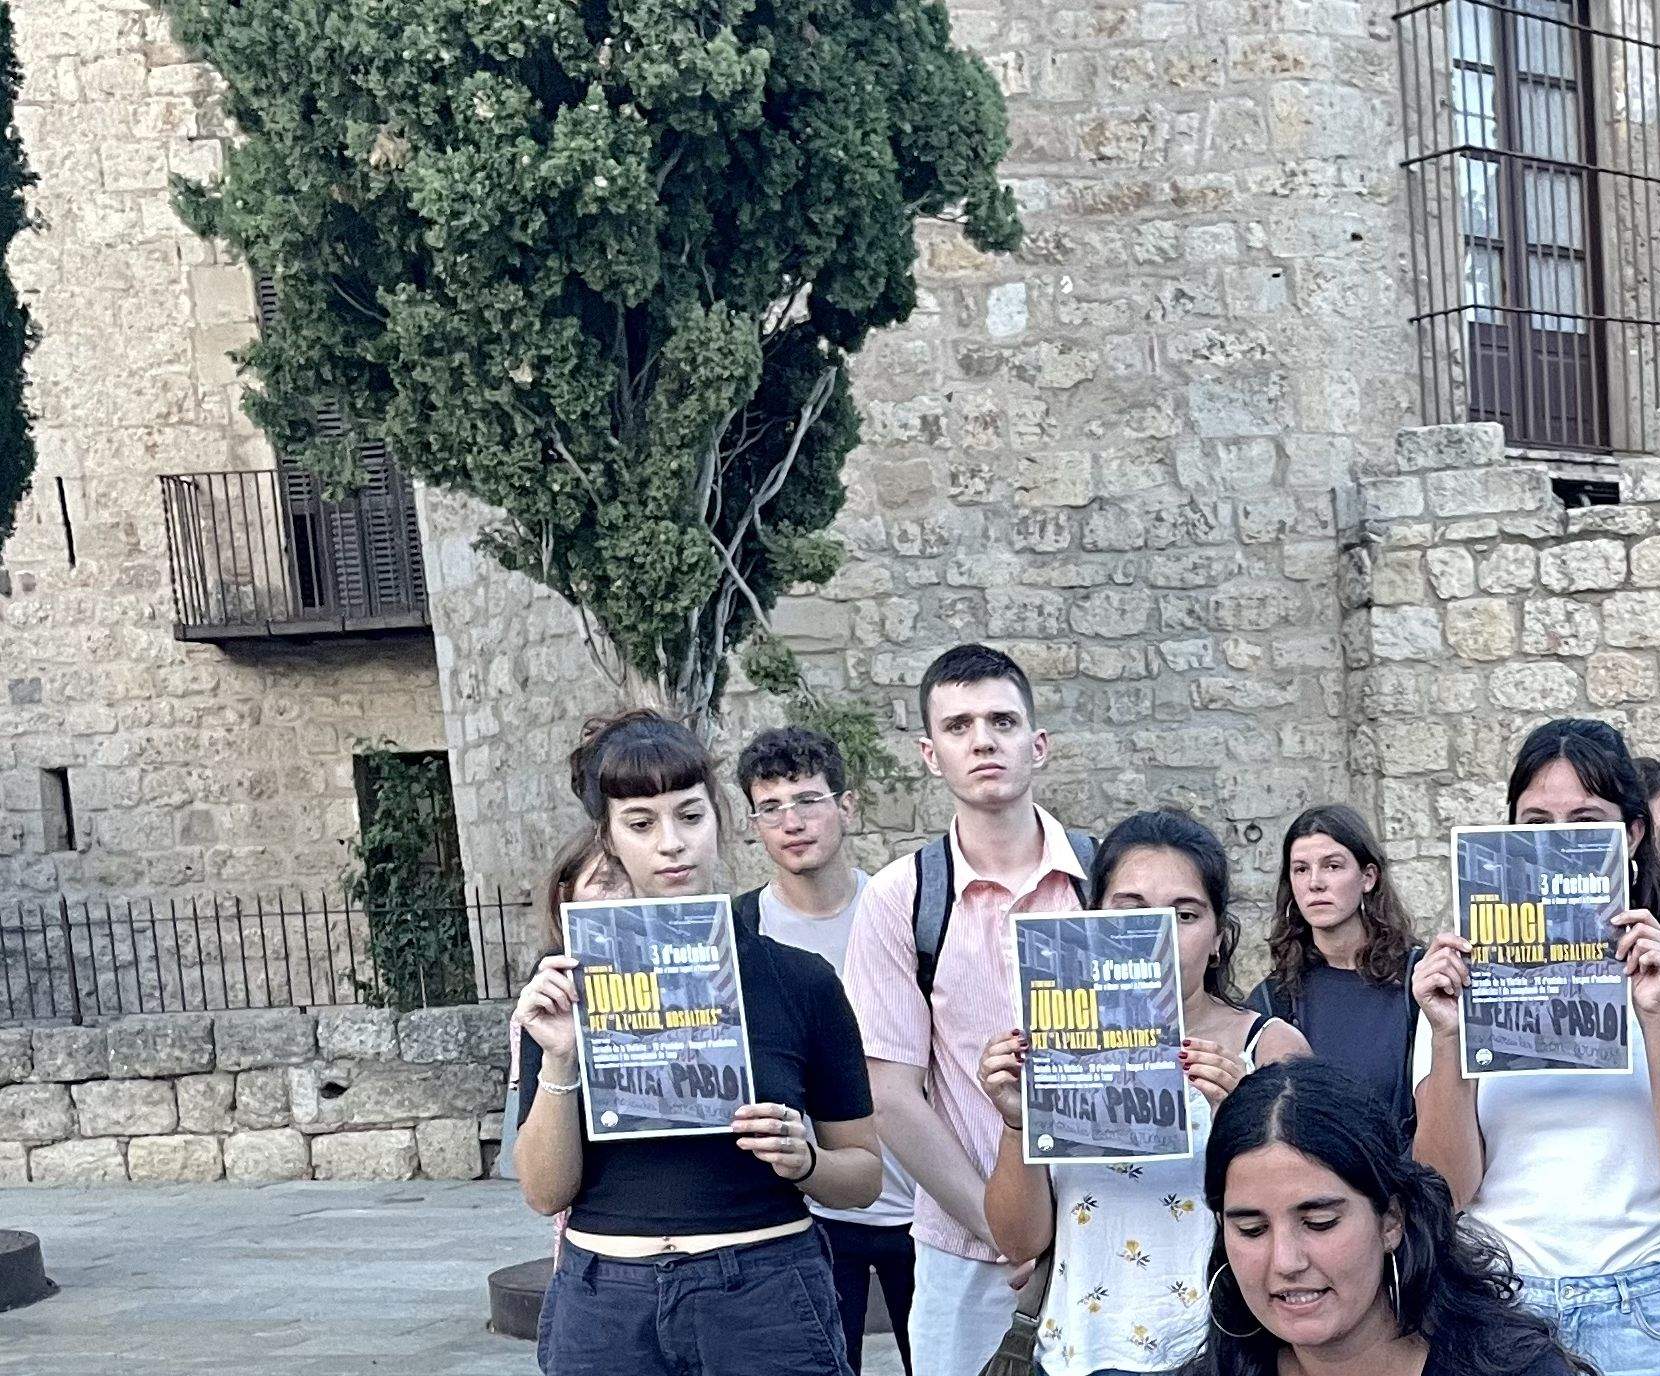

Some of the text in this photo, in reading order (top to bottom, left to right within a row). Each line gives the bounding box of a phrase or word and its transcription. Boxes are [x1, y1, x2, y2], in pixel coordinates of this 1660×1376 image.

[1540, 872, 1610, 896] 3 d'octubre
[1469, 902, 1546, 945] JUDICI
[651, 943, 719, 965] 3 d'octubre
[1092, 958, 1161, 981] 3 d'octubre
[1471, 946, 1489, 964] PER
[584, 972, 660, 1014] JUDICI
[589, 1015, 608, 1031] PER
[1030, 988, 1098, 1030] JUDICI
[1550, 998, 1617, 1041] PABLO
[1032, 1032, 1048, 1051] PER
[670, 1062, 739, 1100] PABLO
[1103, 1086, 1175, 1127] PABLO
